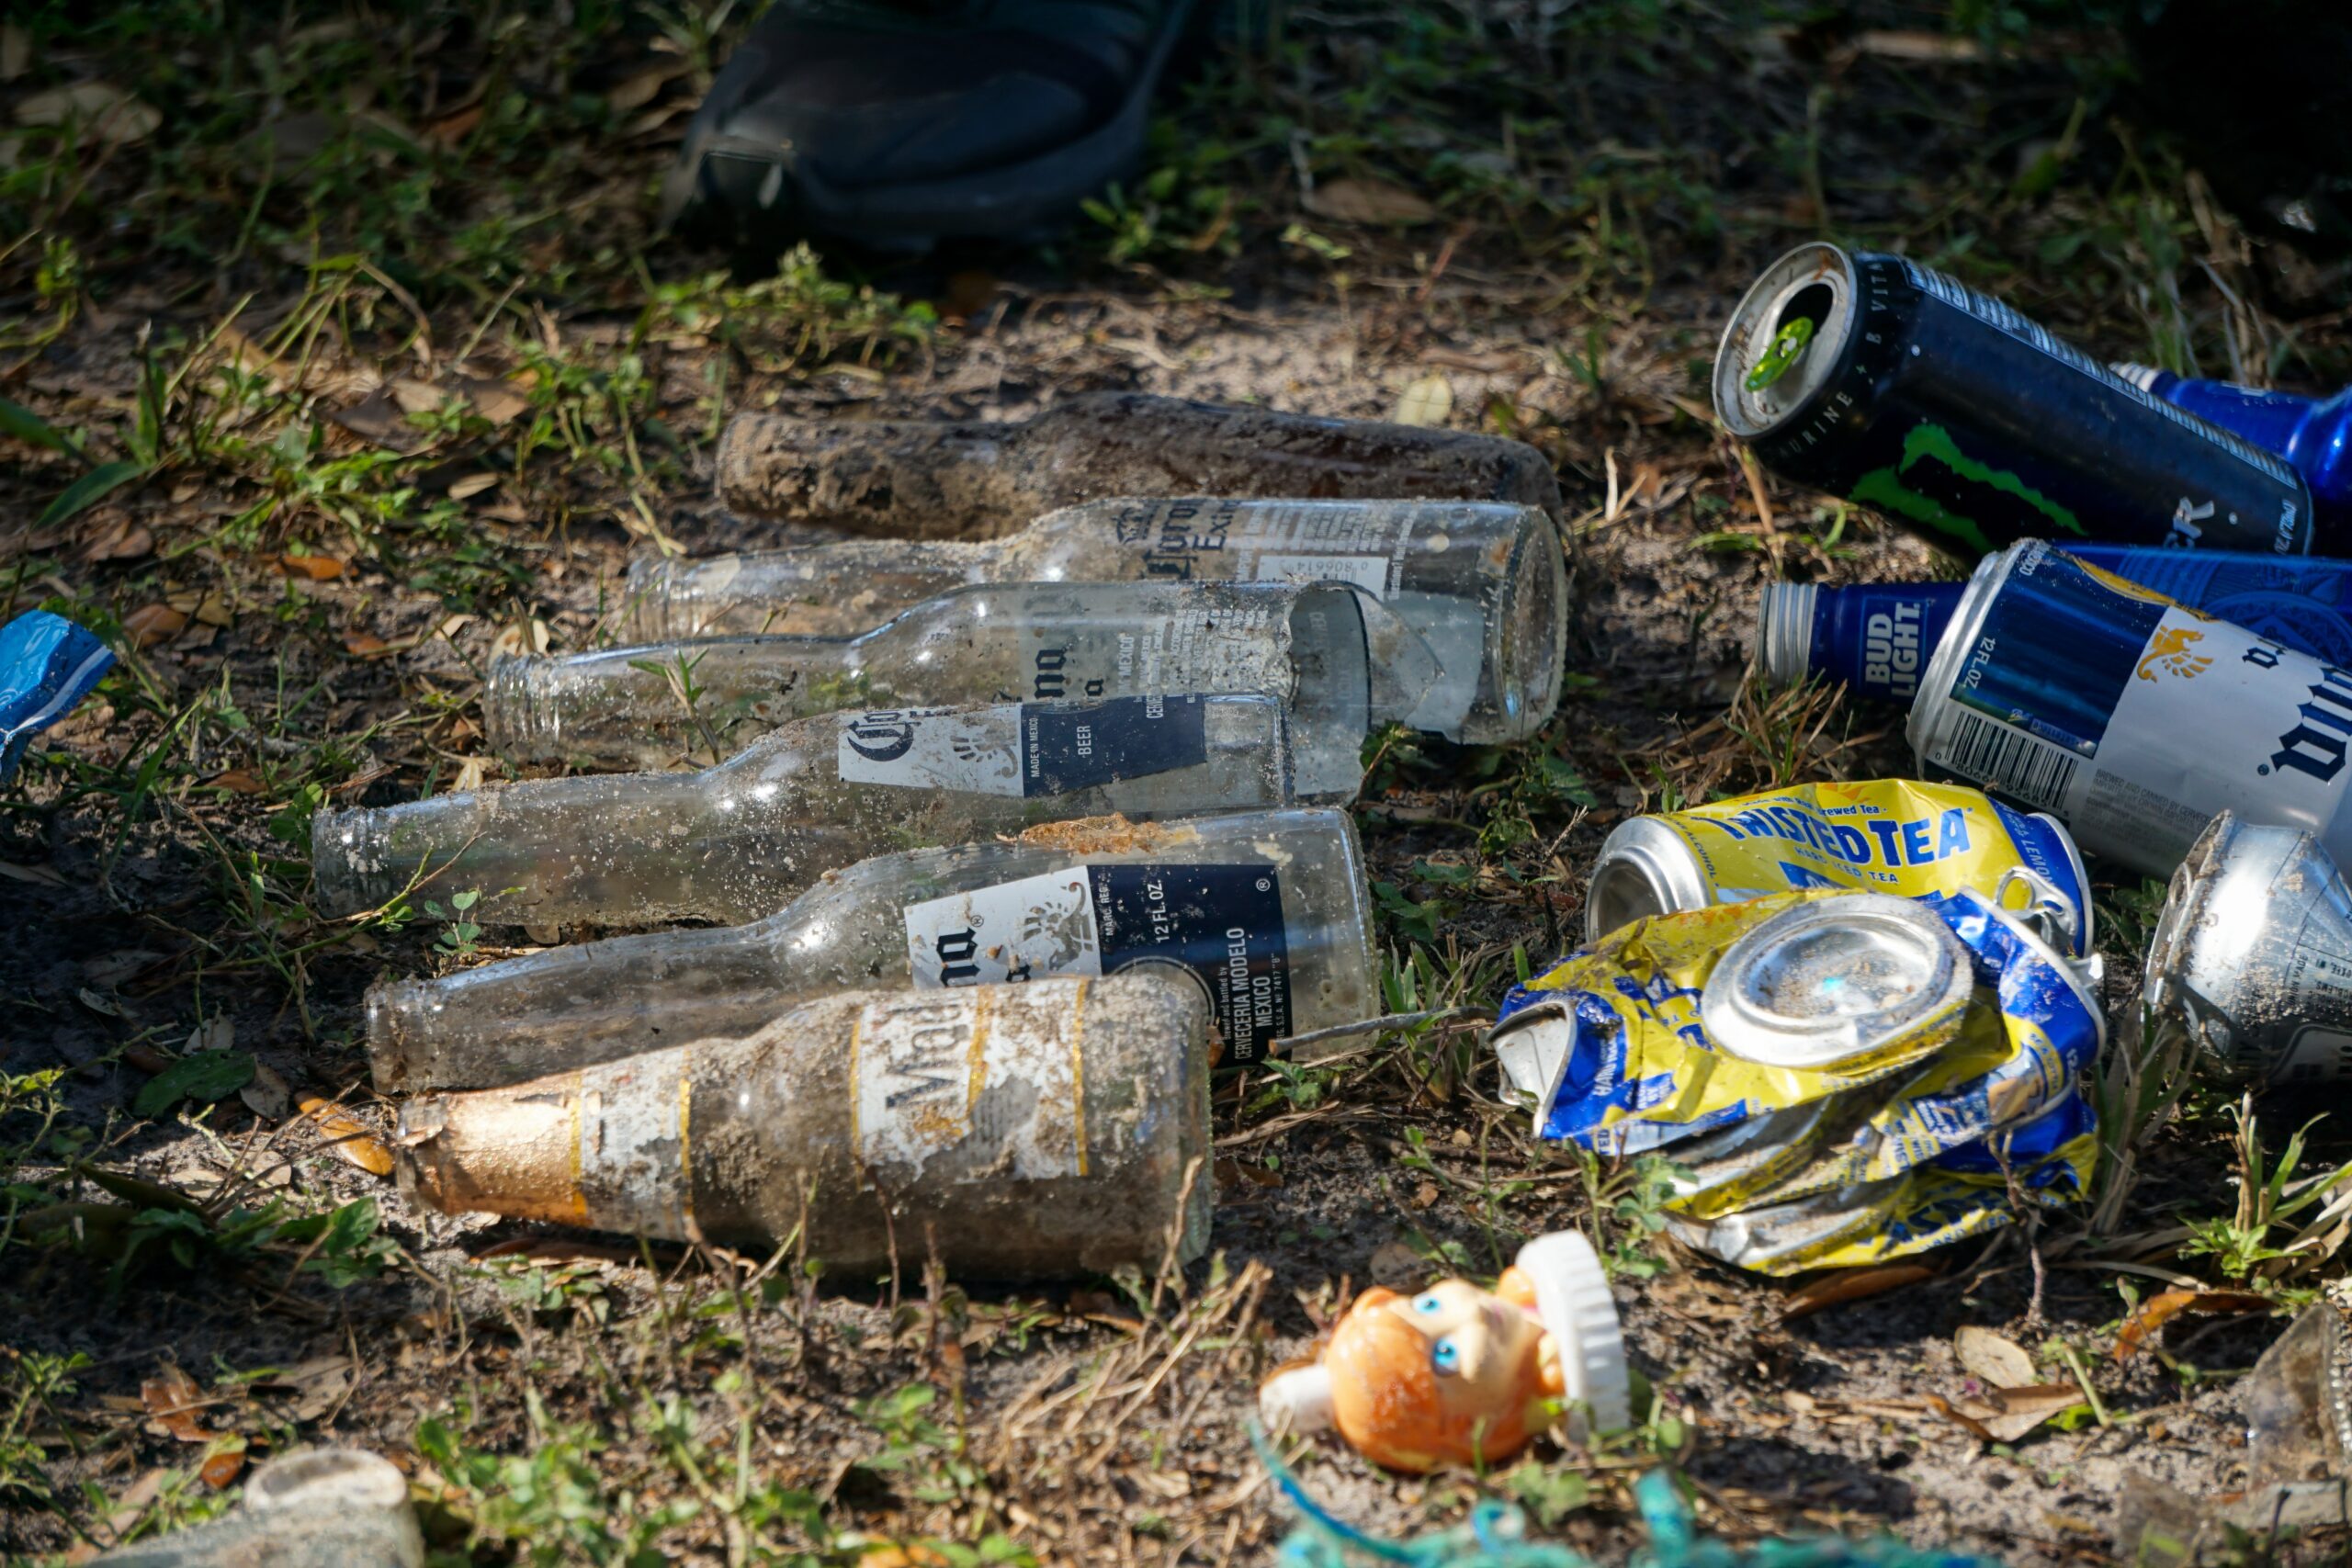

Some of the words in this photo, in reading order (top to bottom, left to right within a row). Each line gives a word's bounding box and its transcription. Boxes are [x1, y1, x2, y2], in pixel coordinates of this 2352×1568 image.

[1868, 263, 1889, 311] VITA
[1866, 332, 1882, 344] B
[1788, 390, 1853, 454] URINE
[1865, 613, 1893, 684] BUD
[1979, 637, 1996, 651] 12
[1030, 716, 1040, 744] MEXICO
[1077, 724, 1091, 756] BEER
[1029, 755, 1040, 778] MADE
[1934, 750, 1942, 761] 0
[1860, 804, 1880, 814] Tea
[1690, 806, 1872, 865] TWISTED
[1868, 807, 1971, 867] TEA
[1794, 845, 1828, 865] HARD
[1832, 861, 1862, 878] ICED
[1867, 870, 1898, 884] TEA
[1147, 879, 1164, 900] OZ.
[1152, 901, 1168, 922] FL.
[1154, 925, 1170, 943] 12
[1226, 928, 1250, 991] MODELO
[1272, 970, 1283, 991] 7417
[1252, 976, 1273, 1027] MEXICO
[1234, 994, 1252, 1060] CERVECERIA
